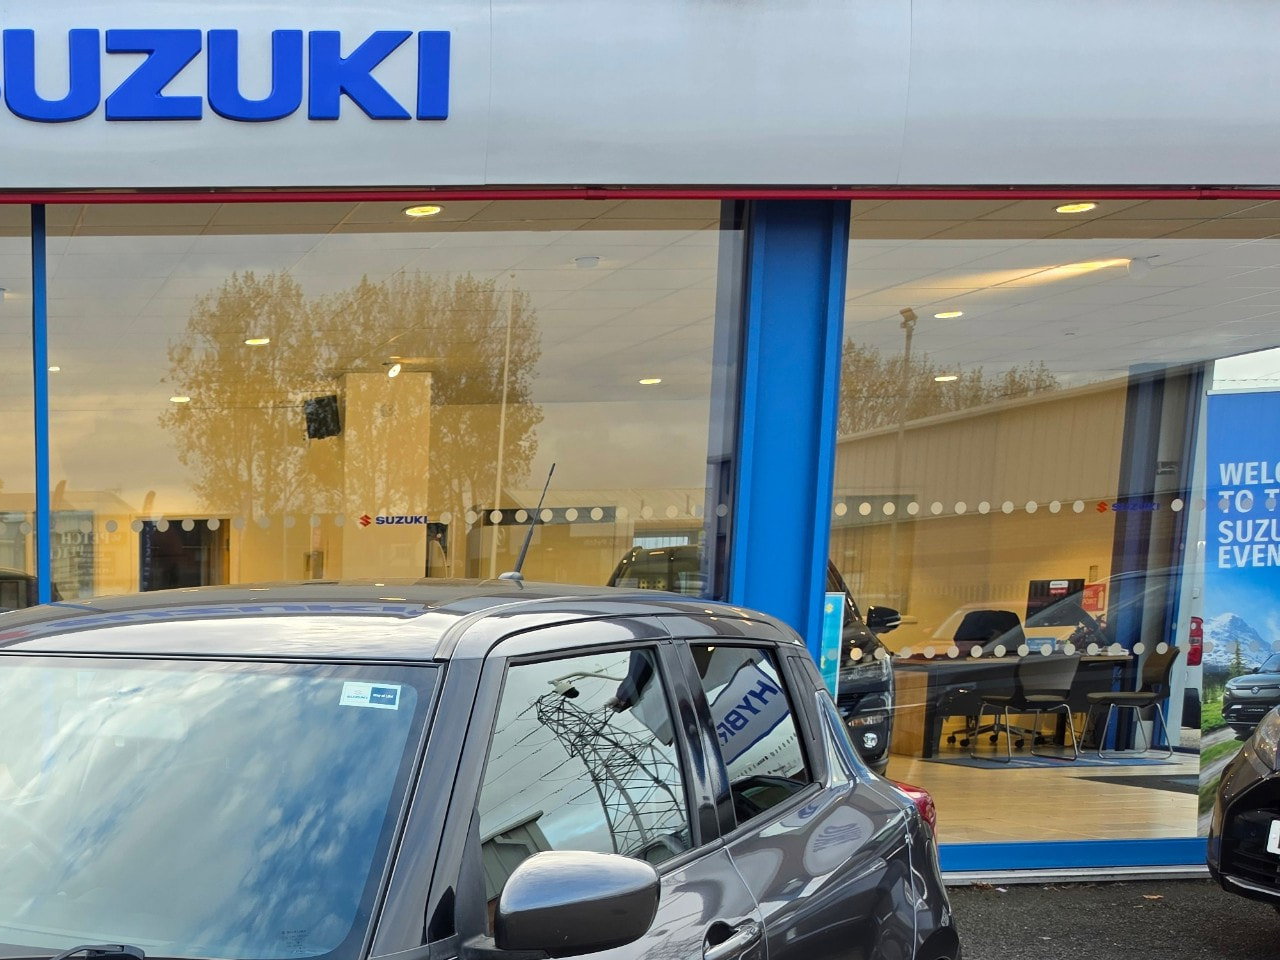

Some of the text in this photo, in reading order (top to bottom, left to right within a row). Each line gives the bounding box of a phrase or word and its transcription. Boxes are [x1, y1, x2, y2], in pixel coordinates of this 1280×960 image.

[1219, 461, 1280, 486] WEL
[1111, 503, 1160, 512] SUZUKI
[1218, 490, 1254, 513] TO
[375, 516, 428, 525] SUZUKI
[1218, 544, 1280, 569] EVEN
